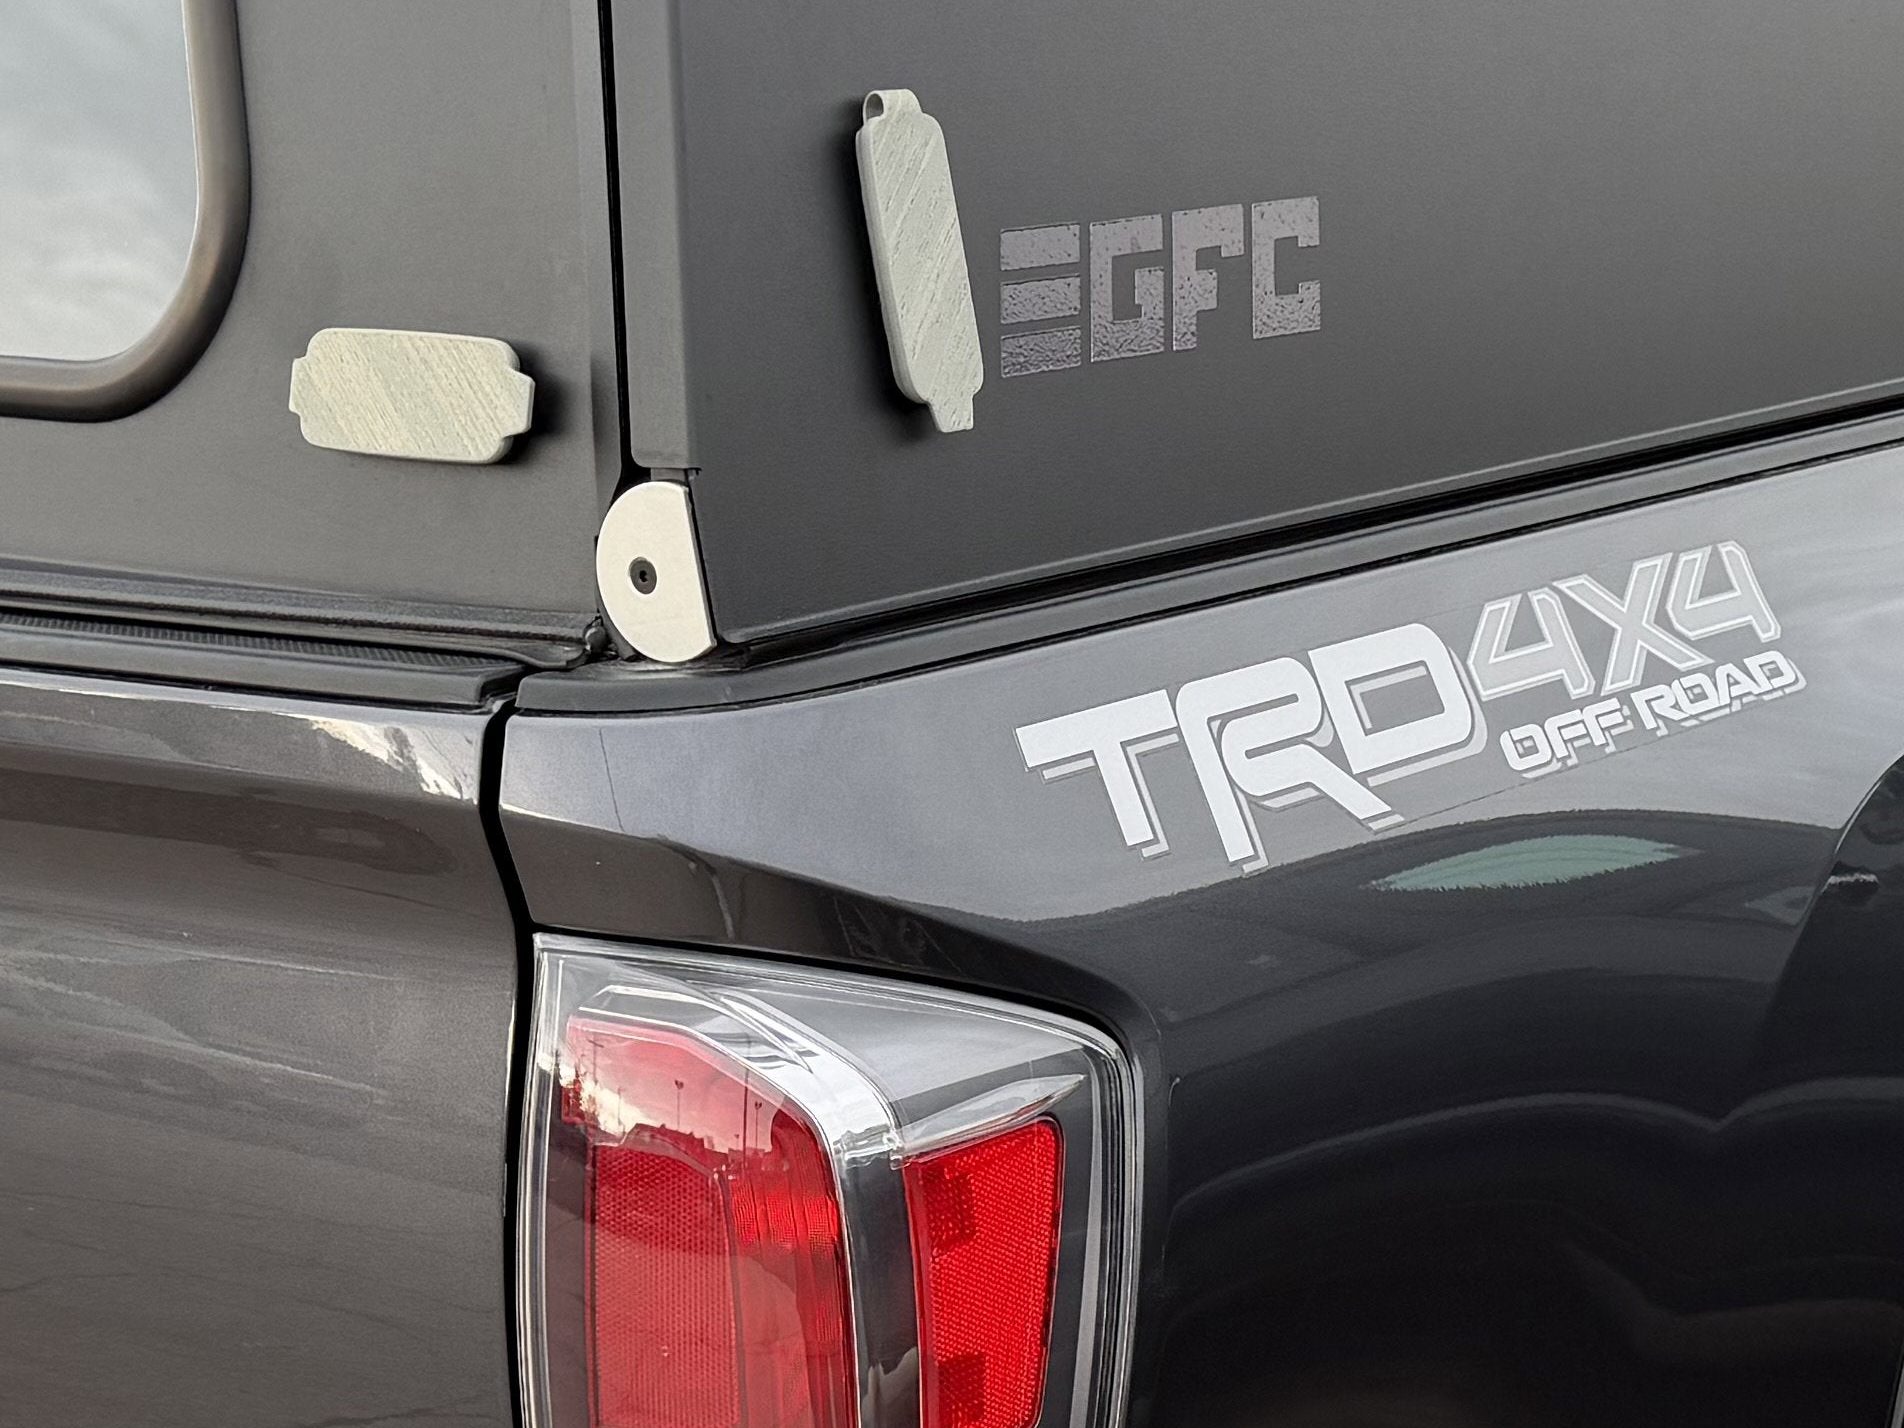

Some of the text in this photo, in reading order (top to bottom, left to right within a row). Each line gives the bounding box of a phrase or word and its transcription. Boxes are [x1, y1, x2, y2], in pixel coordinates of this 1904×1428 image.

[1015, 540, 1782, 875] TRD 4X4
[1500, 651, 1807, 777] OFF ROAD
